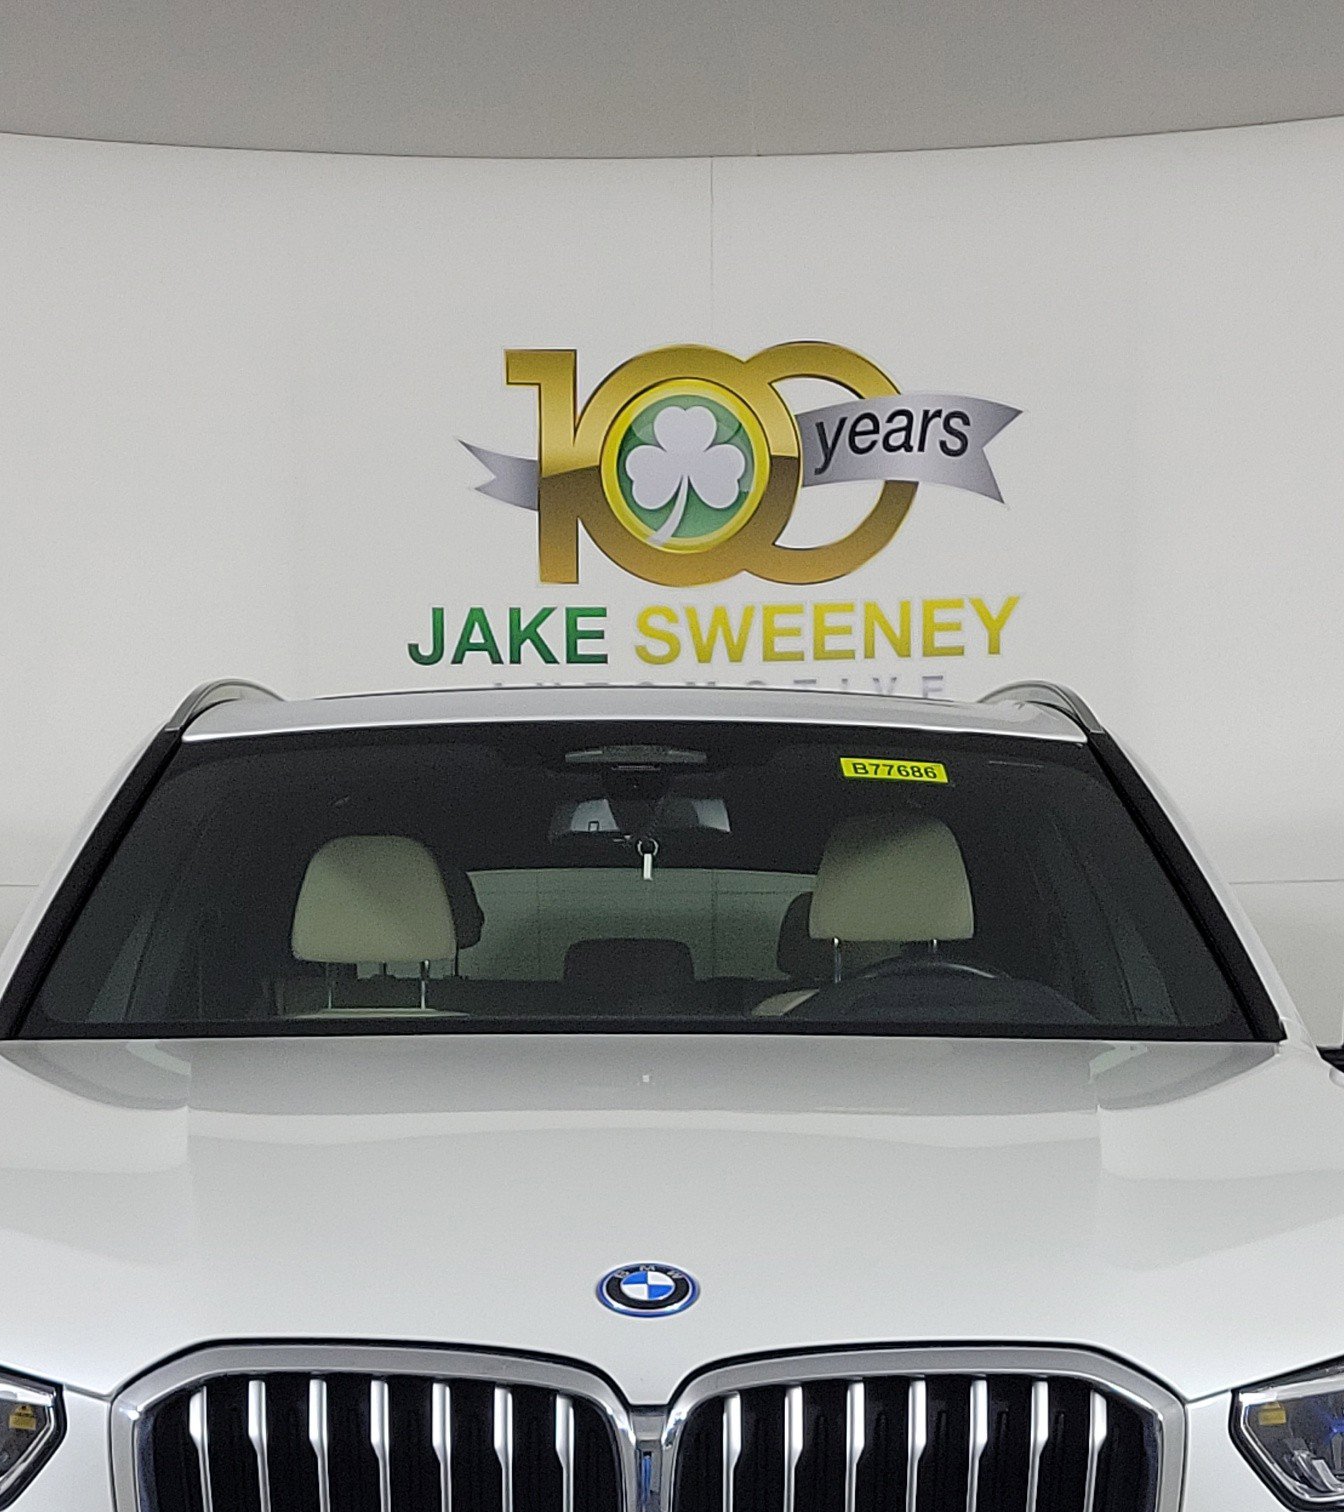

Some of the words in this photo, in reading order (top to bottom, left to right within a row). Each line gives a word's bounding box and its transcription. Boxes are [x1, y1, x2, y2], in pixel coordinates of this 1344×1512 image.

[504, 341, 919, 587] 100
[813, 407, 971, 476] years
[408, 606, 608, 665] JAKE
[634, 596, 1020, 663] SWEENEY
[851, 762, 938, 779] B77686
